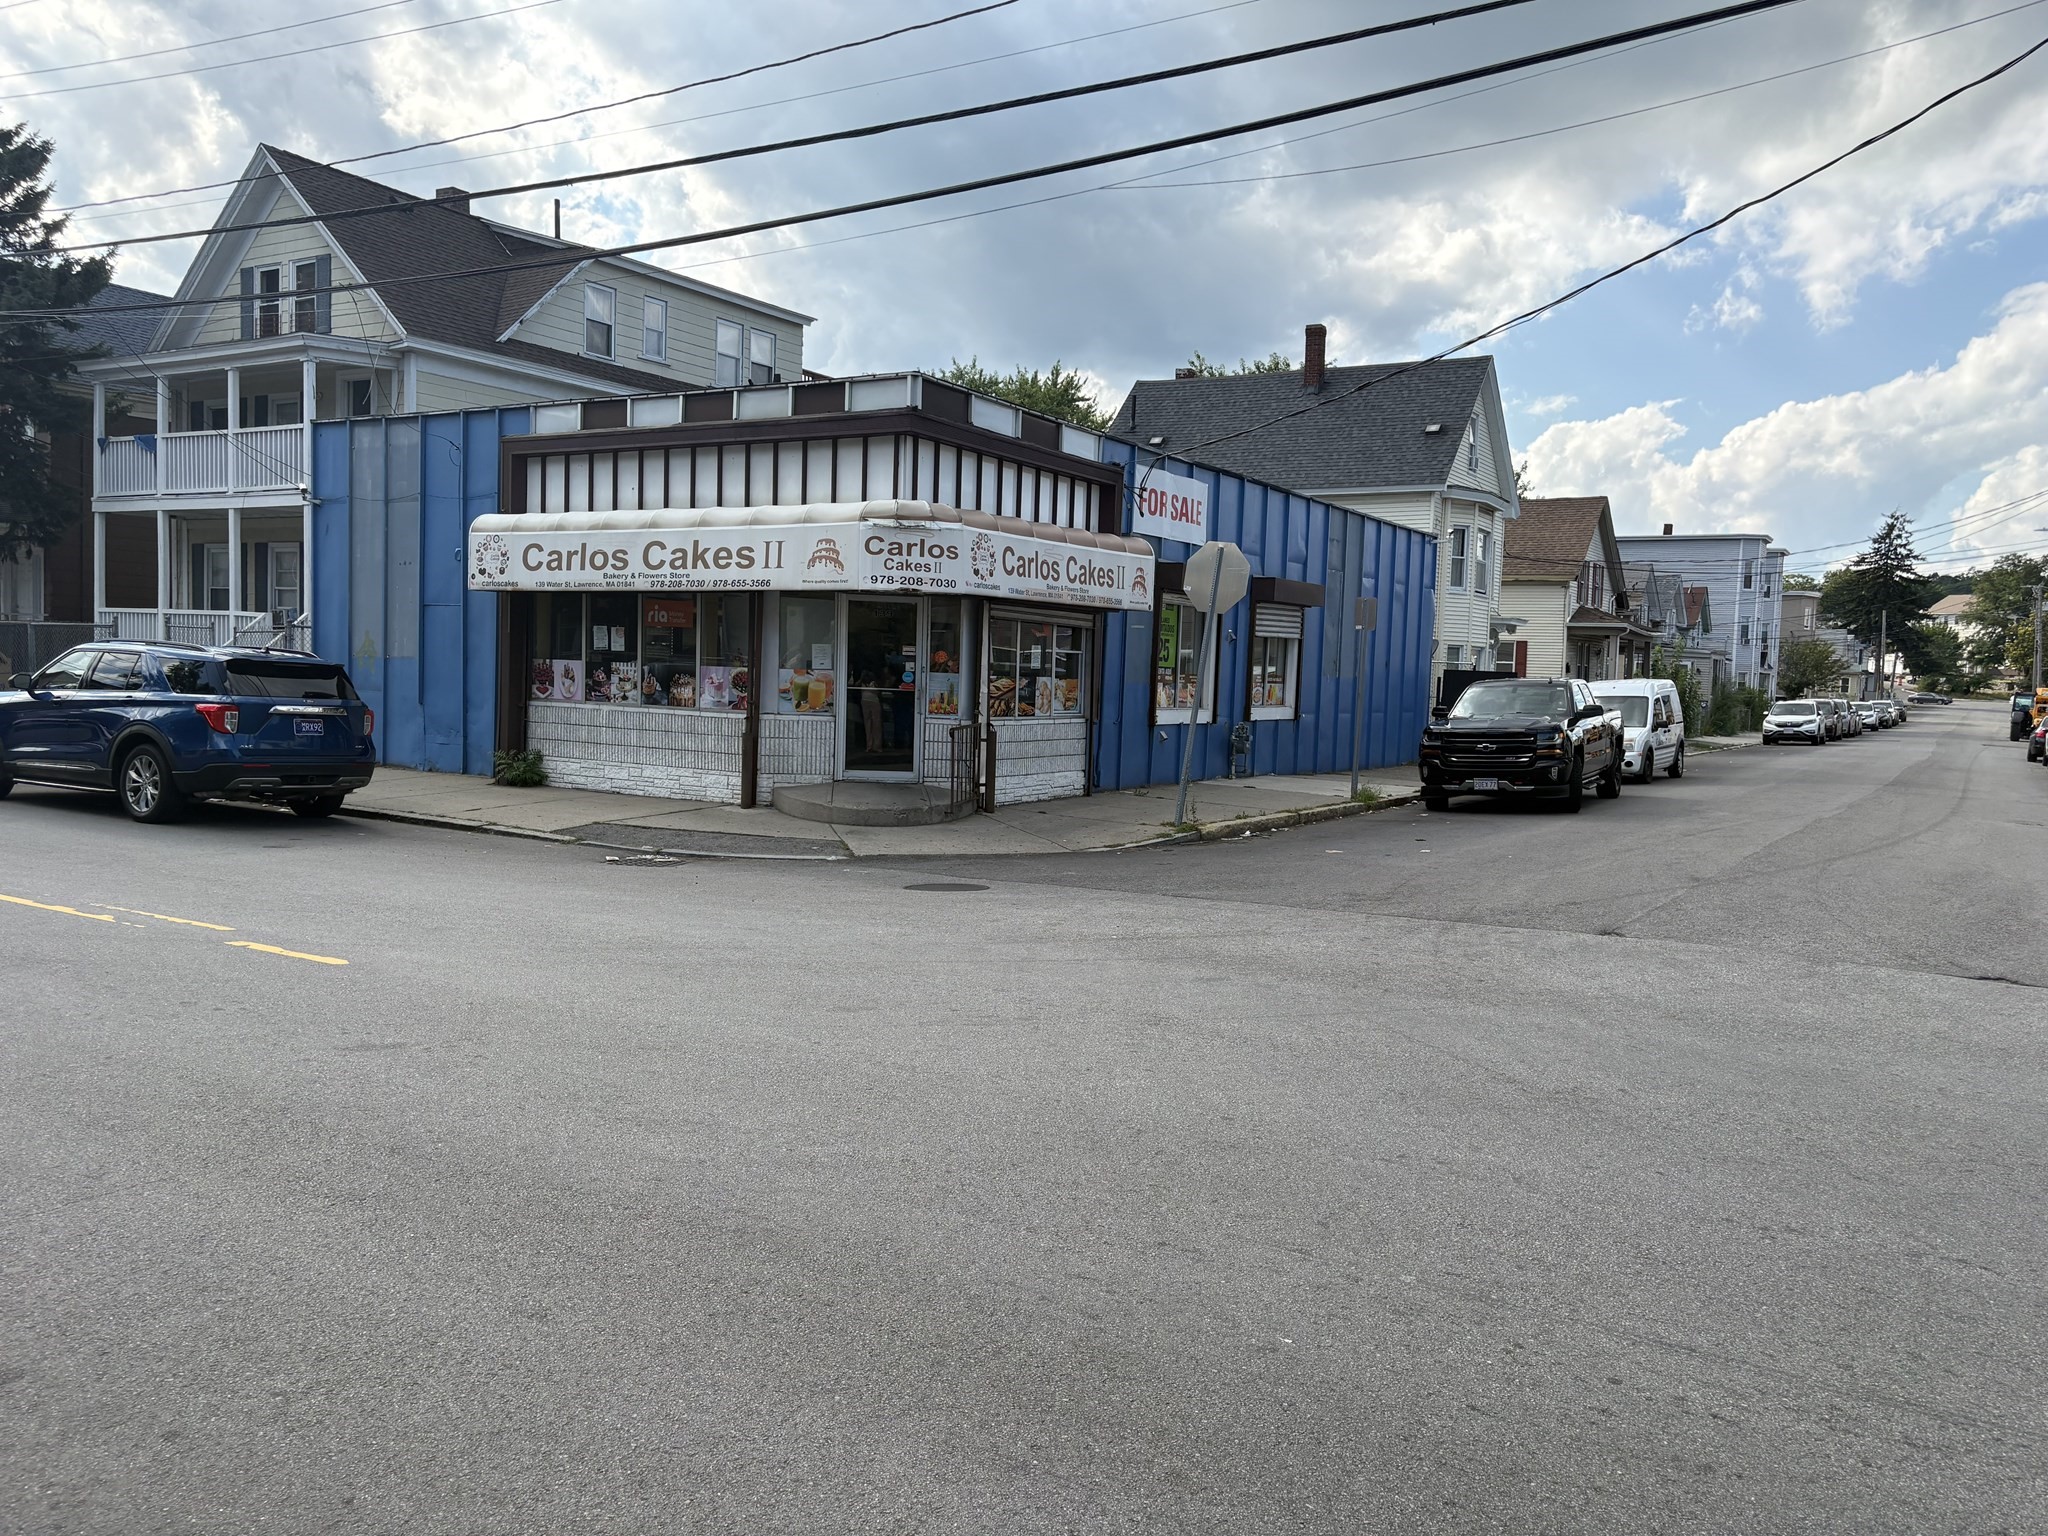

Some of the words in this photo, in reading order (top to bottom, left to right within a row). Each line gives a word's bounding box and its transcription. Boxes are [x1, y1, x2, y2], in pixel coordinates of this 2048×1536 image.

[1140, 487, 1167, 518] FOR
[1171, 494, 1202, 526] SALE
[864, 535, 959, 560] Carlos
[522, 542, 629, 572] Carlos
[642, 540, 755, 571] Cakes
[761, 540, 785, 570] II
[883, 558, 932, 573] Cakes
[934, 562, 942, 574] II
[1002, 545, 1060, 582] Carlos
[1066, 555, 1114, 588] Cakes
[1117, 565, 1125, 590] II
[603, 572, 629, 580] Bakery
[870, 575, 957, 589] 978-208-7030
[481, 580, 519, 588] carloscakes
[564, 581, 573, 589] St,
[650, 580, 706, 588] 978-208-7030
[712, 579, 771, 588] 978-655-3566
[974, 582, 1000, 591] carloscakes
[1046, 583, 1060, 592] Bakery
[647, 604, 668, 623] ria
